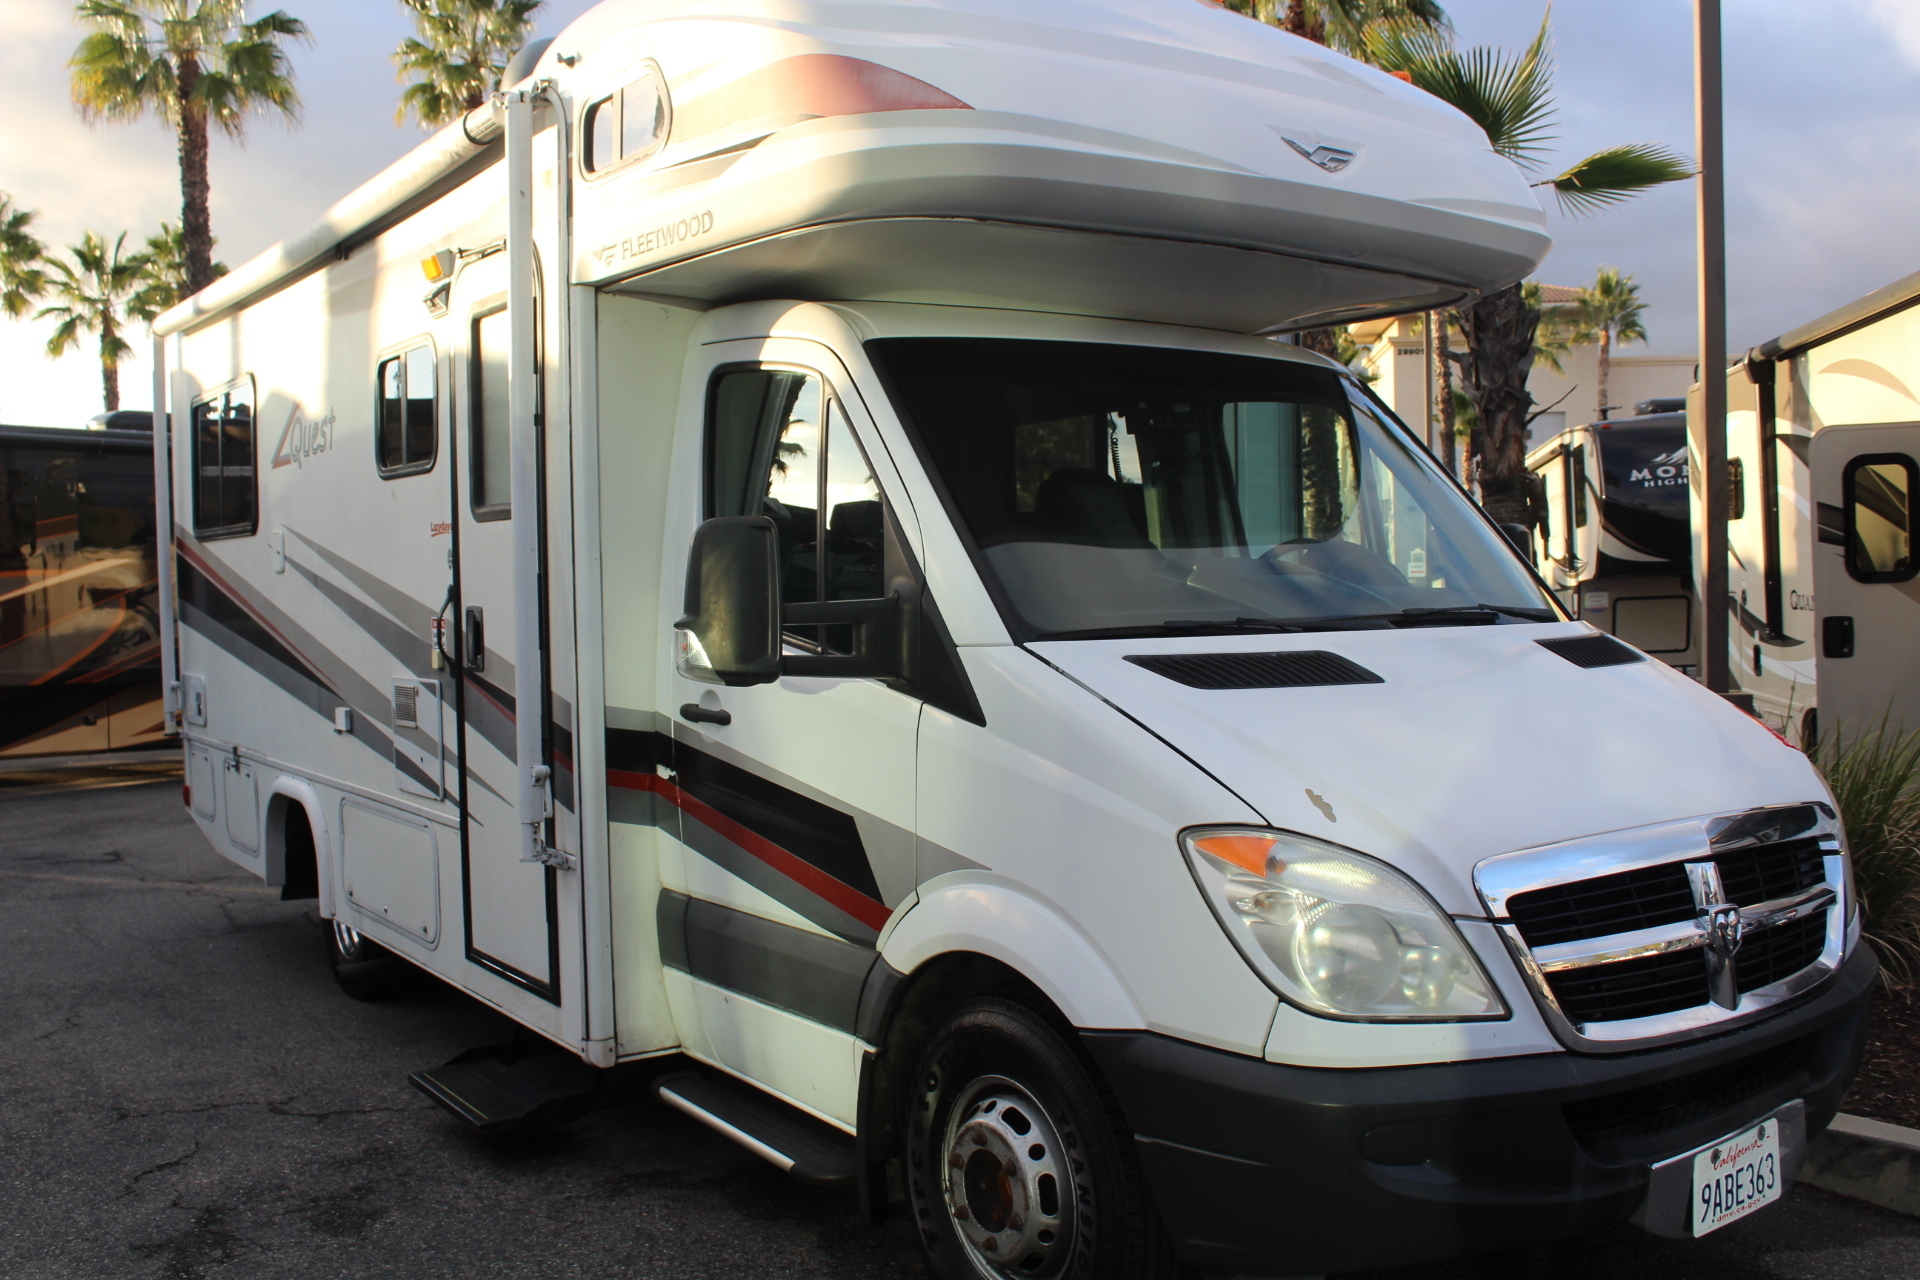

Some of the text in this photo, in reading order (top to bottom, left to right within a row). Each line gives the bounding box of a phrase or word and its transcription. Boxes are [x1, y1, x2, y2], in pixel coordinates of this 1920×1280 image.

[621, 209, 714, 260] FLEETWOOD
[1713, 1139, 1763, 1170] California
[1701, 1152, 1775, 1223] 9ABE363
[1716, 1196, 1761, 1222] dmv.ca.gov
